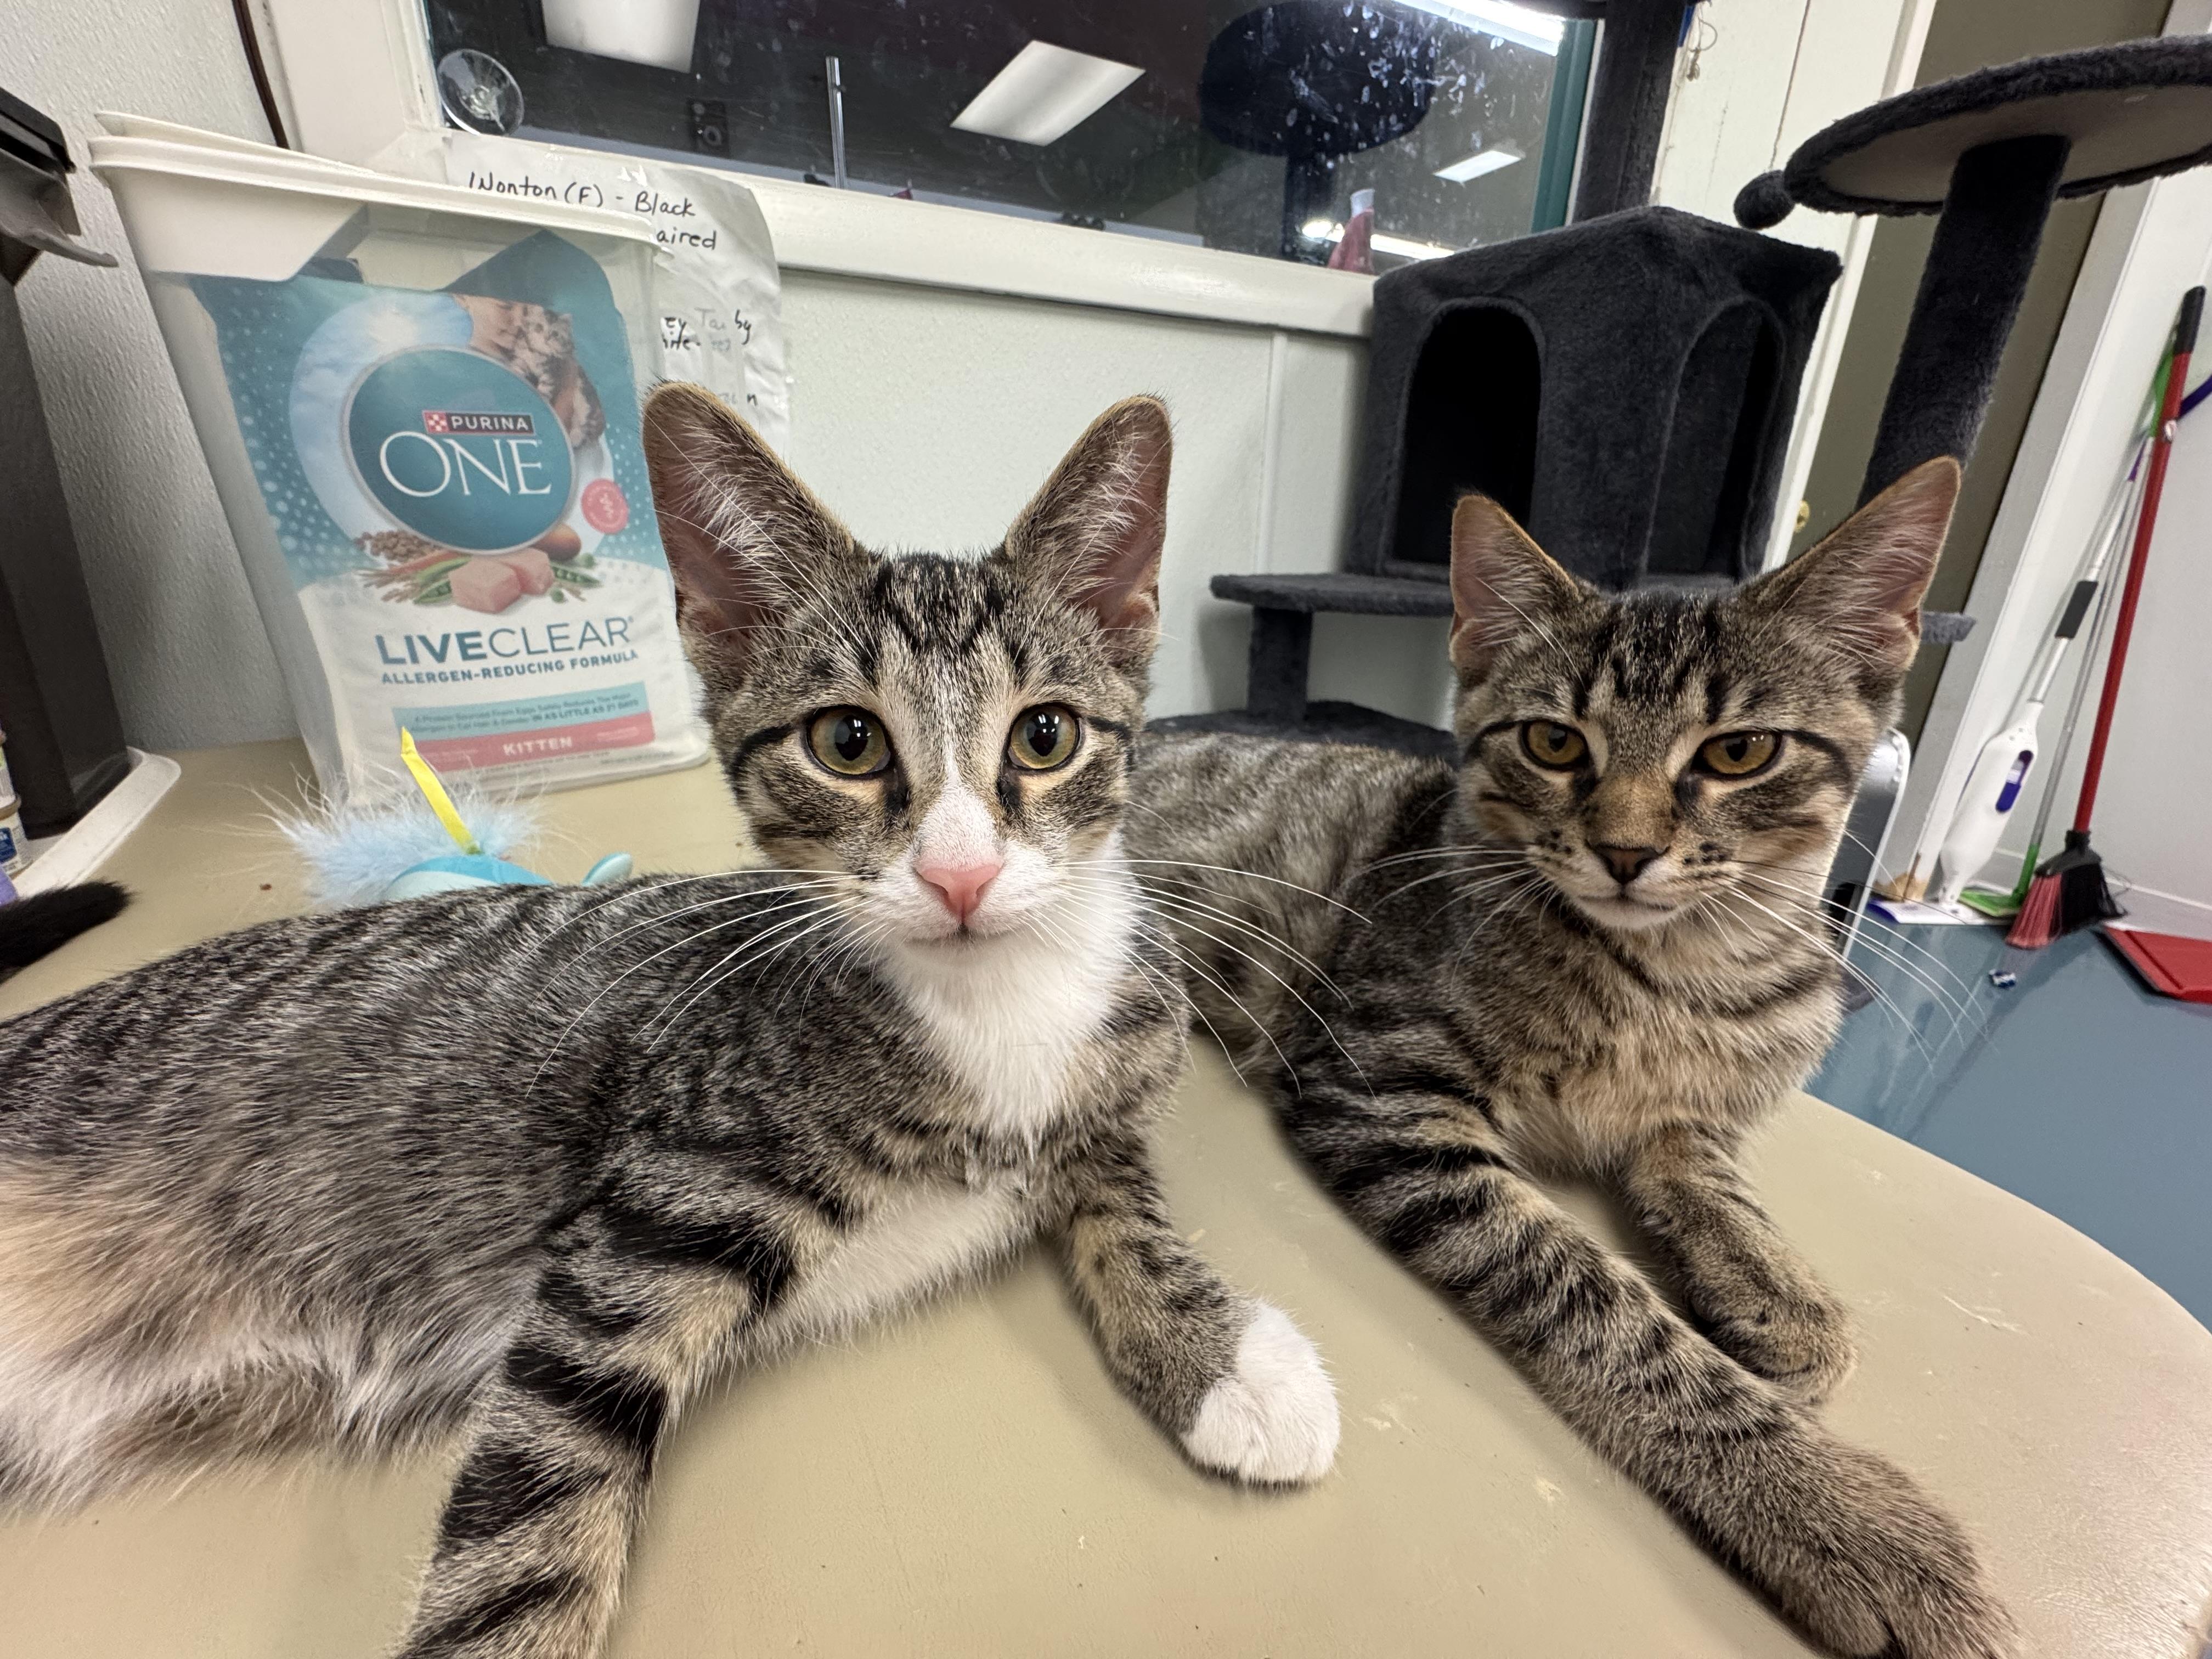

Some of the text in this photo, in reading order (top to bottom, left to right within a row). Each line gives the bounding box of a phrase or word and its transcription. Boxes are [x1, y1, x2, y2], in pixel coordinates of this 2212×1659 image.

[635, 190, 696, 216] Black
[657, 226, 716, 250] aired
[450, 415, 529, 431] PURINA
[380, 431, 551, 498] ONE
[381, 649, 639, 684] ALLERGEN-REDUCING FORMULA
[503, 737, 573, 757] KITTEN
